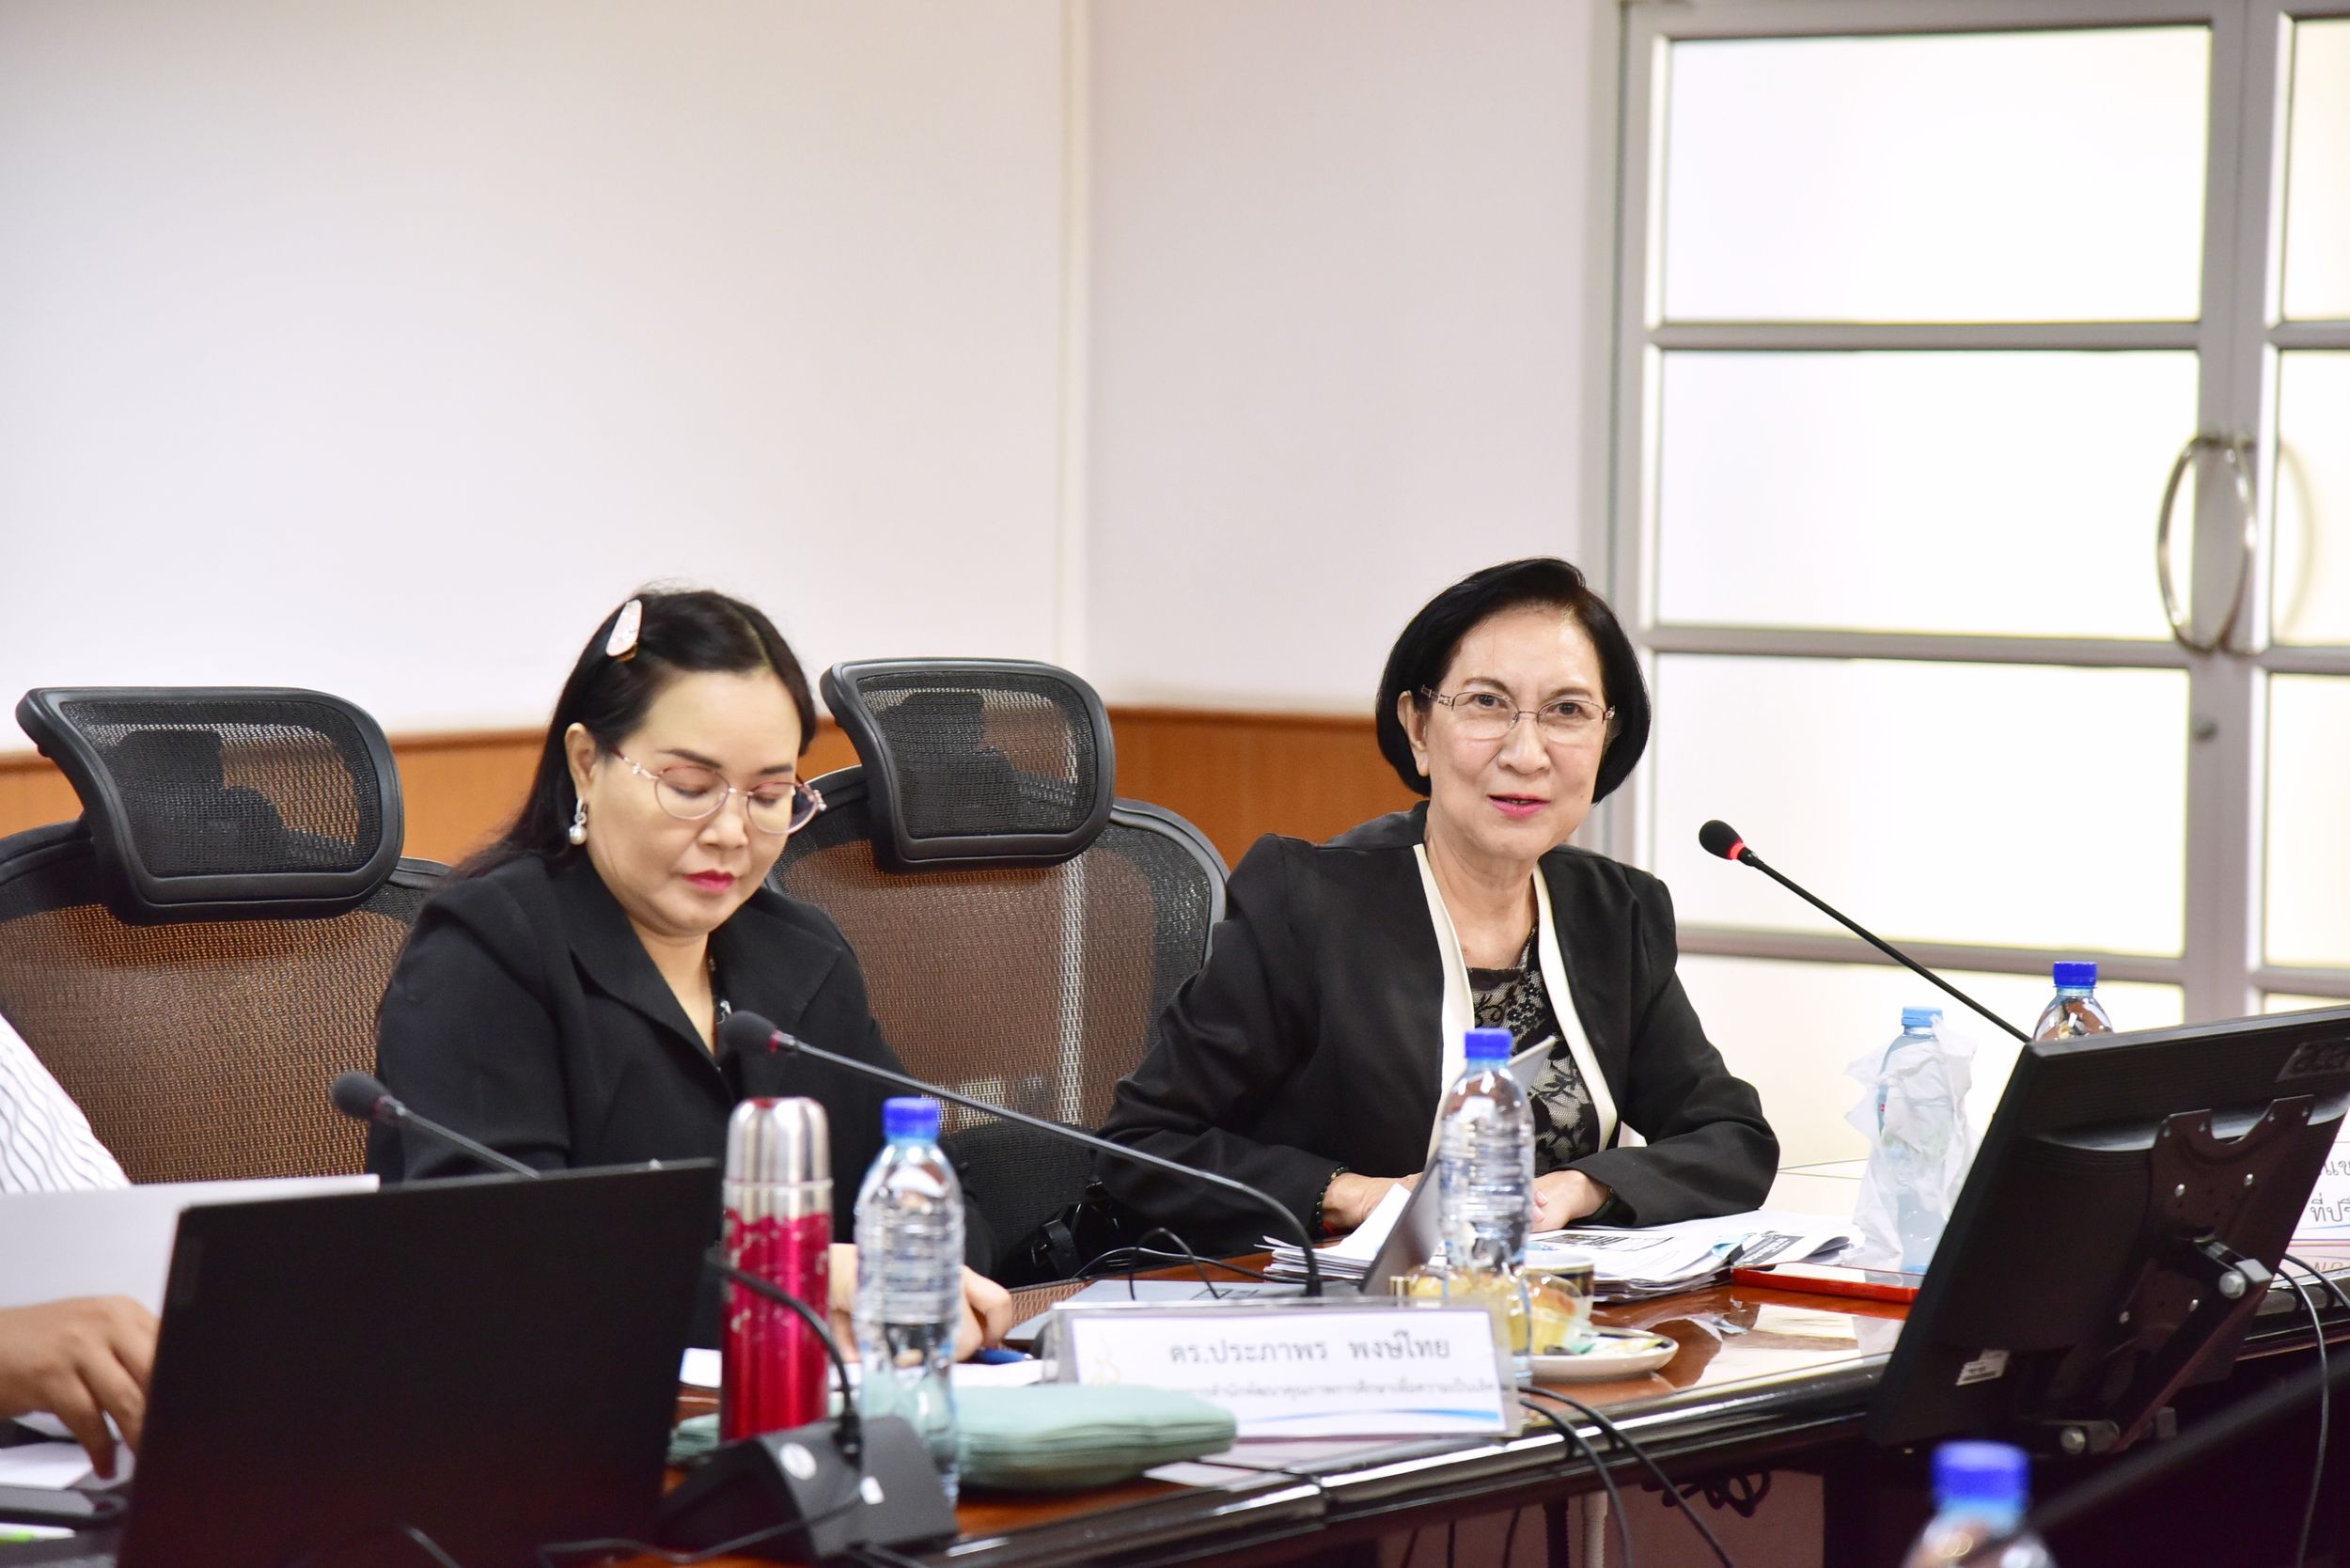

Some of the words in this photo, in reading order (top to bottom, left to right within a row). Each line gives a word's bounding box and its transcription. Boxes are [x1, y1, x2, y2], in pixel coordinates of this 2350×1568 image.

[1170, 1337, 1328, 1364] ดร.ประภาพร
[1348, 1329, 1450, 1359] พงษ์ไทย
